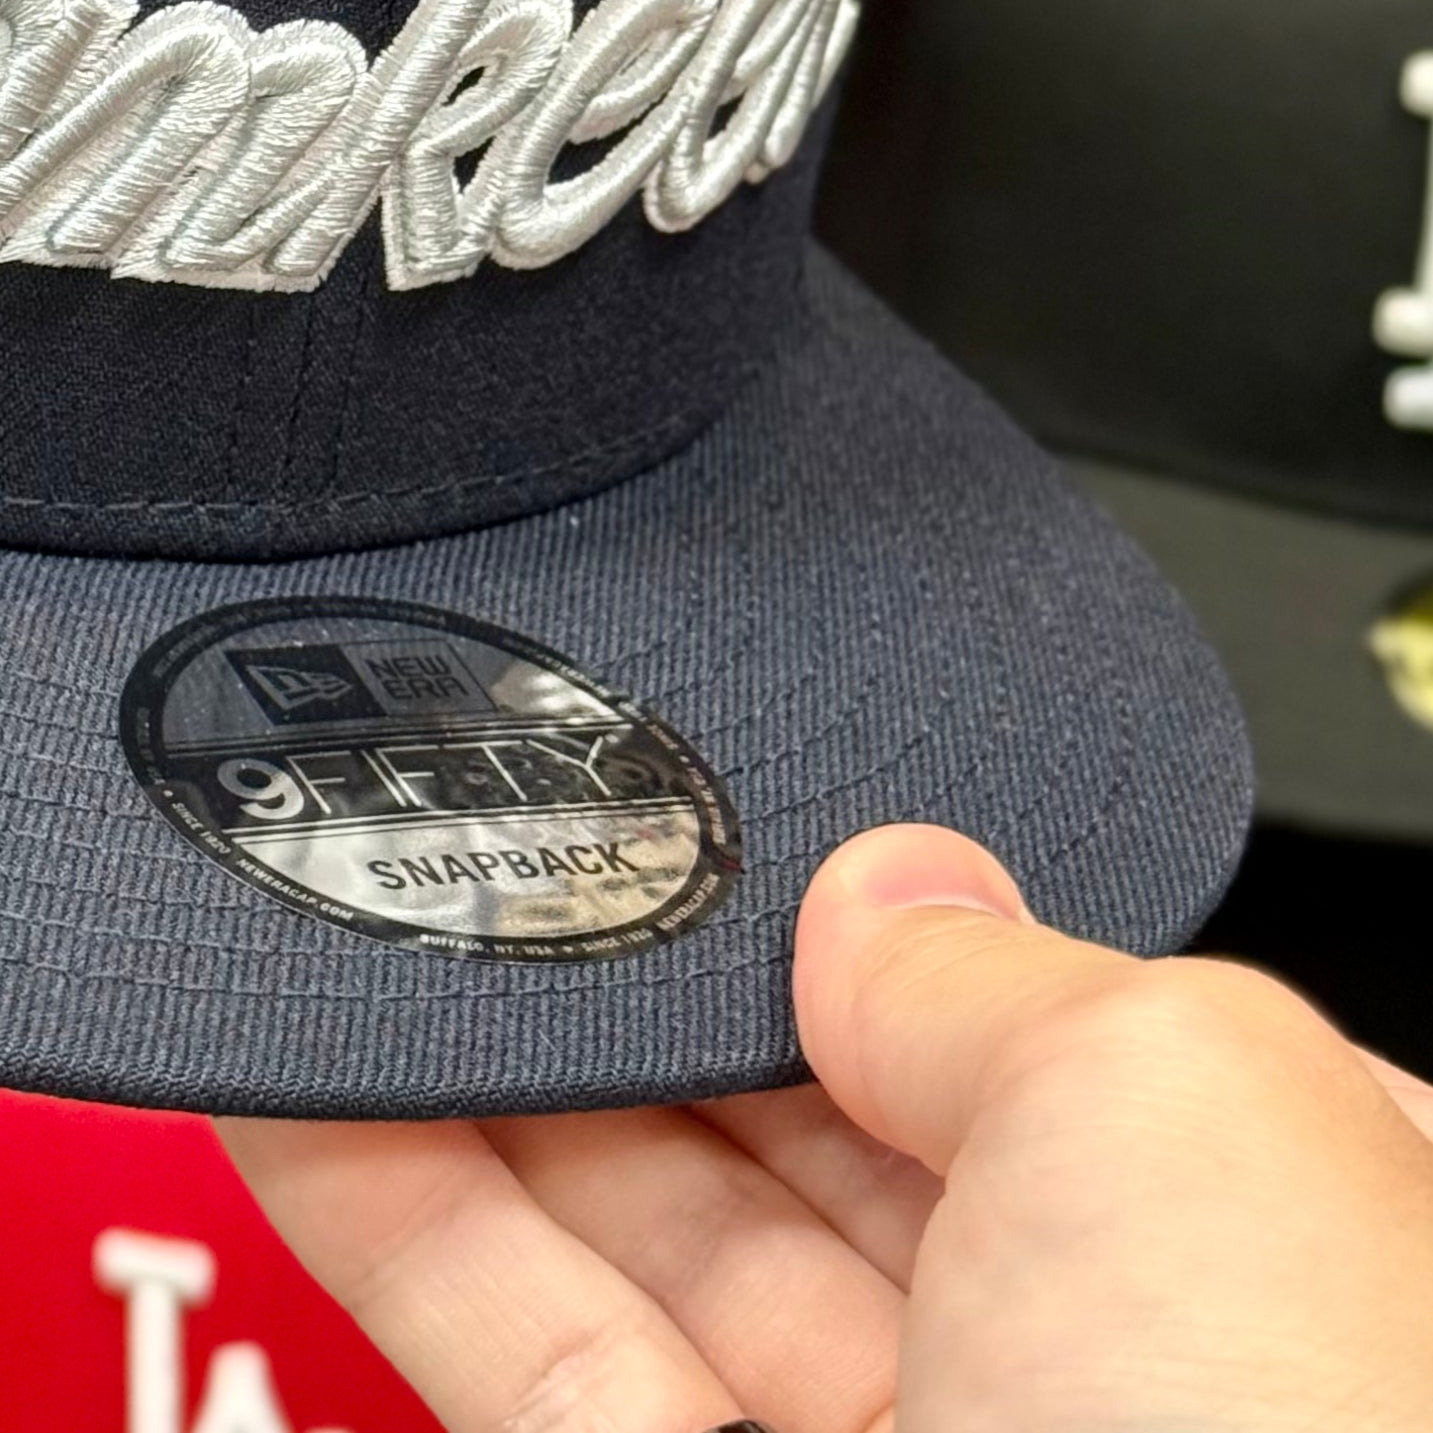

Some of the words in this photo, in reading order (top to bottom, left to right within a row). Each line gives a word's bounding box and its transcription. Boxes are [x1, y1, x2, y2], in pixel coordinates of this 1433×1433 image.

[367, 654, 452, 679] NEW
[380, 677, 469, 700] ERA
[217, 736, 611, 820] 9FIFTY
[367, 841, 640, 890] SNAPBACK
